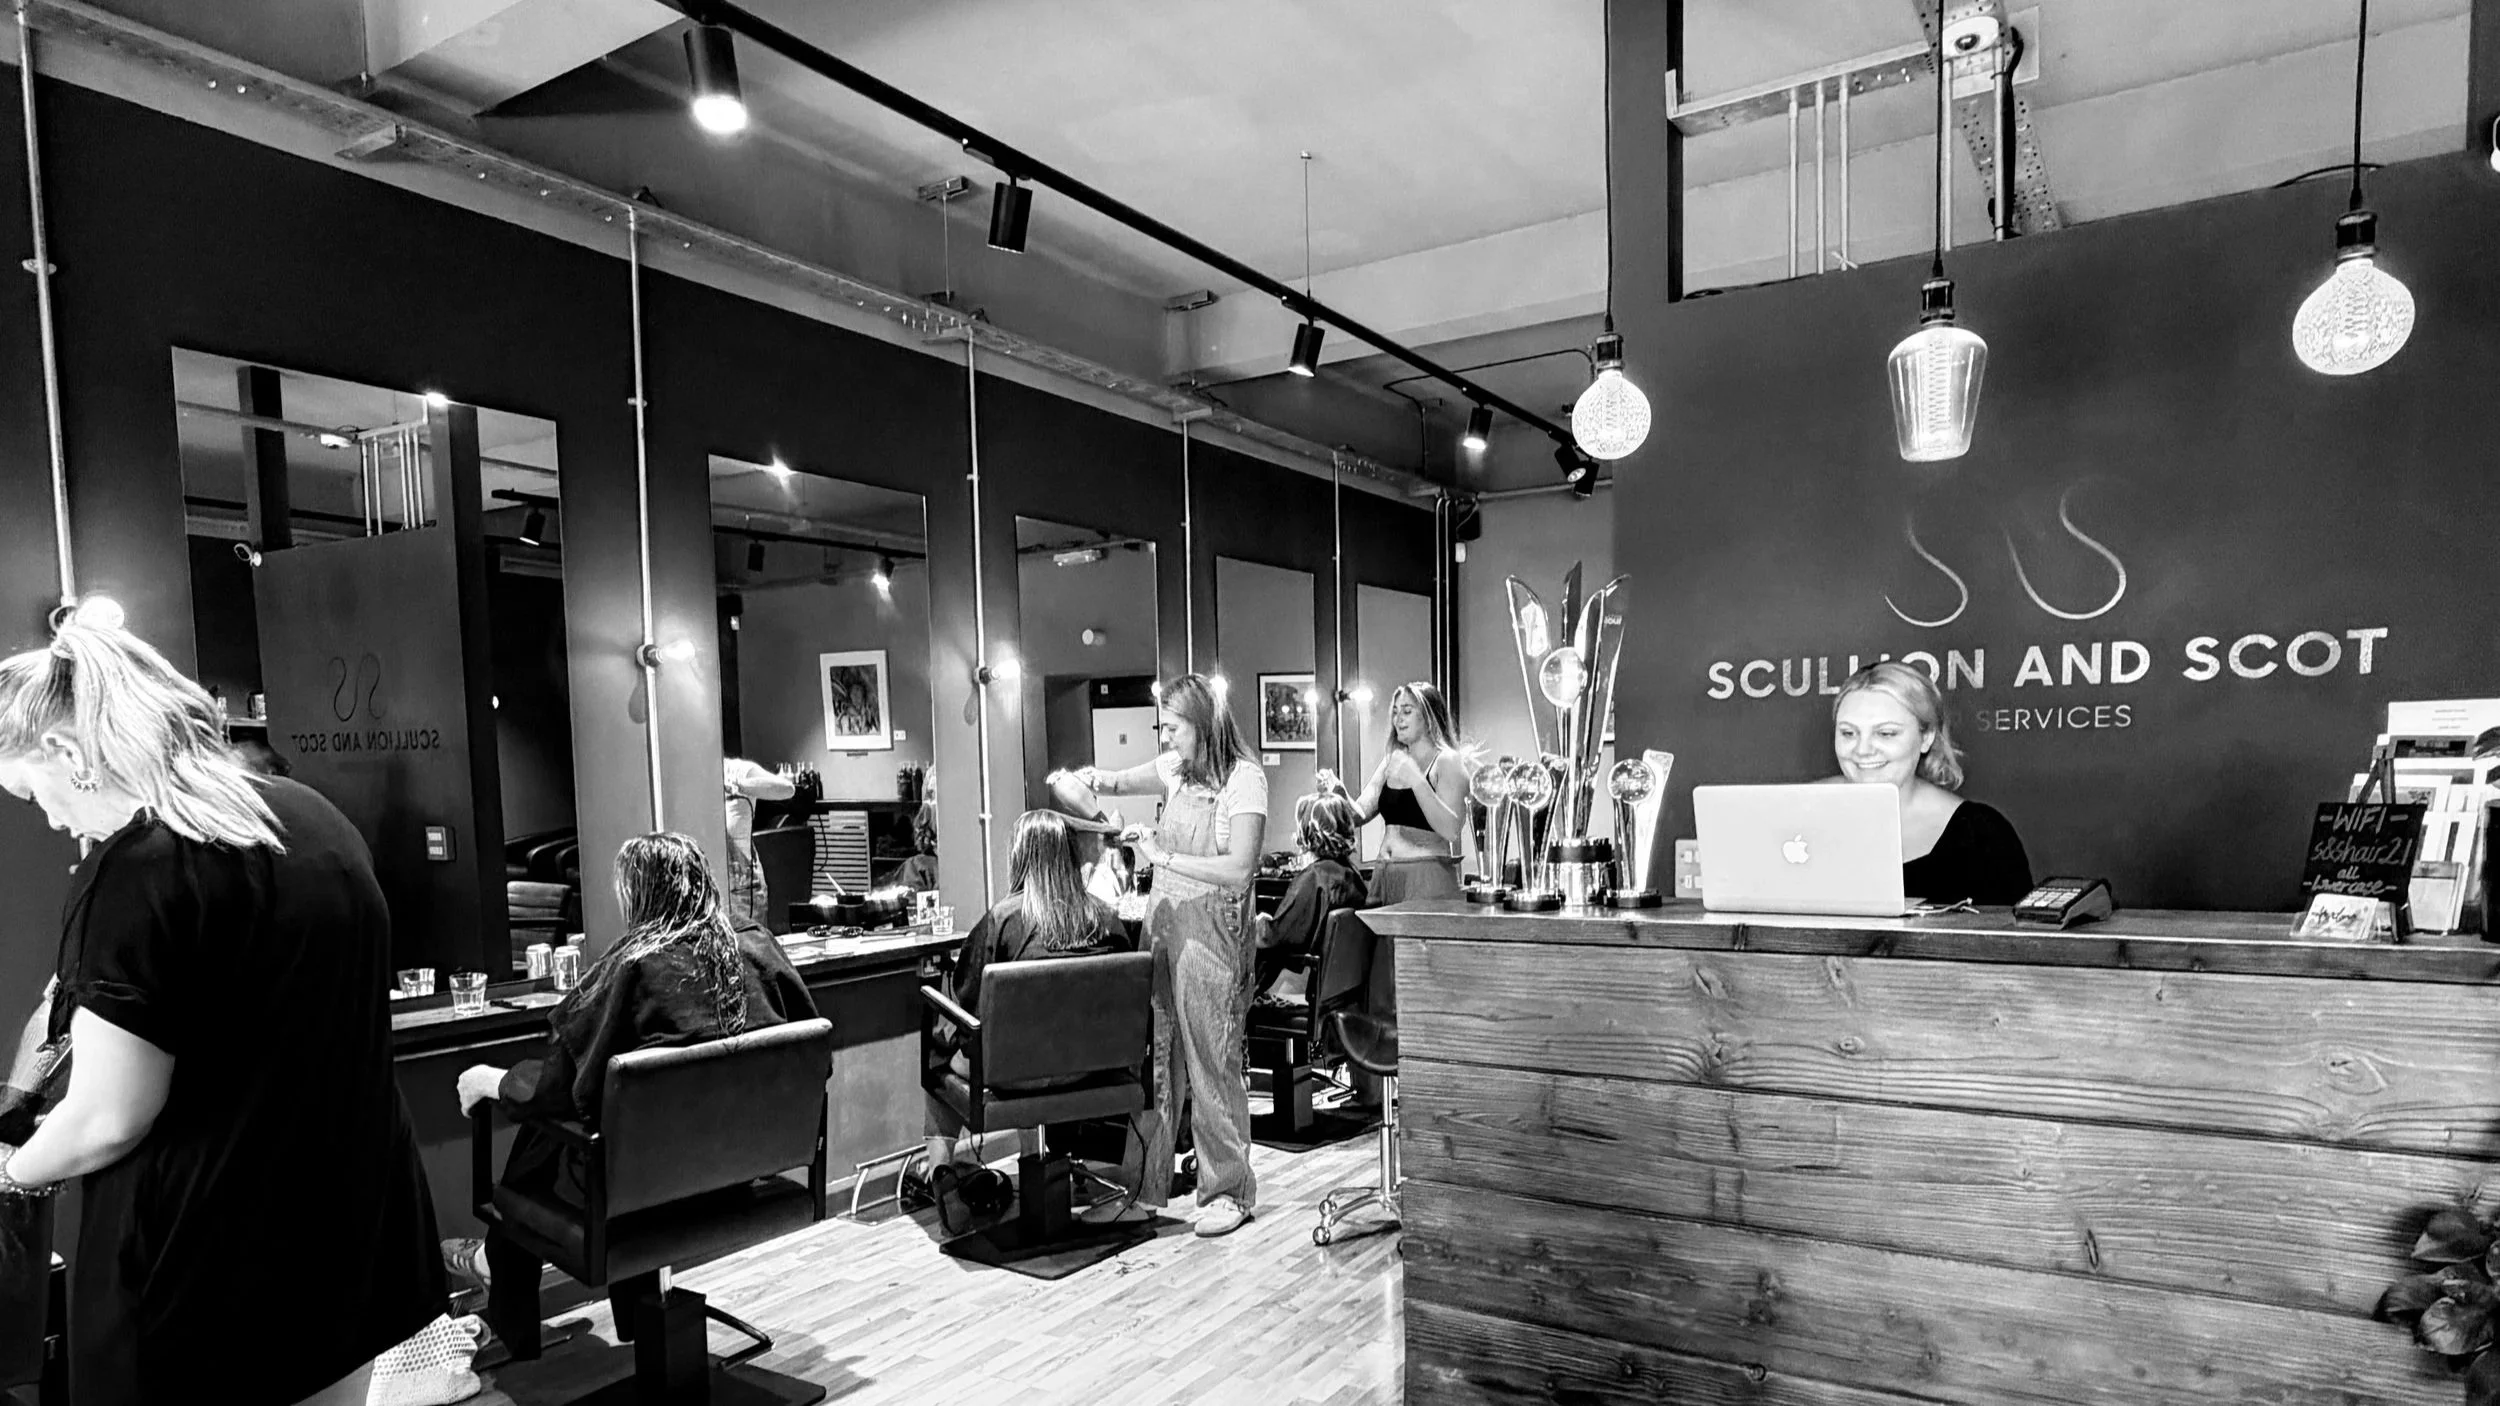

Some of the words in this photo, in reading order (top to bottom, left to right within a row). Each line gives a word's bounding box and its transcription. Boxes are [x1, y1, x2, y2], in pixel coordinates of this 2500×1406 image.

[1706, 648, 1985, 700] SCULON
[2013, 640, 2151, 688] AND
[2181, 627, 2389, 682] SCOT
[1976, 704, 2132, 732] SERVICES
[2336, 865, 2360, 880] all
